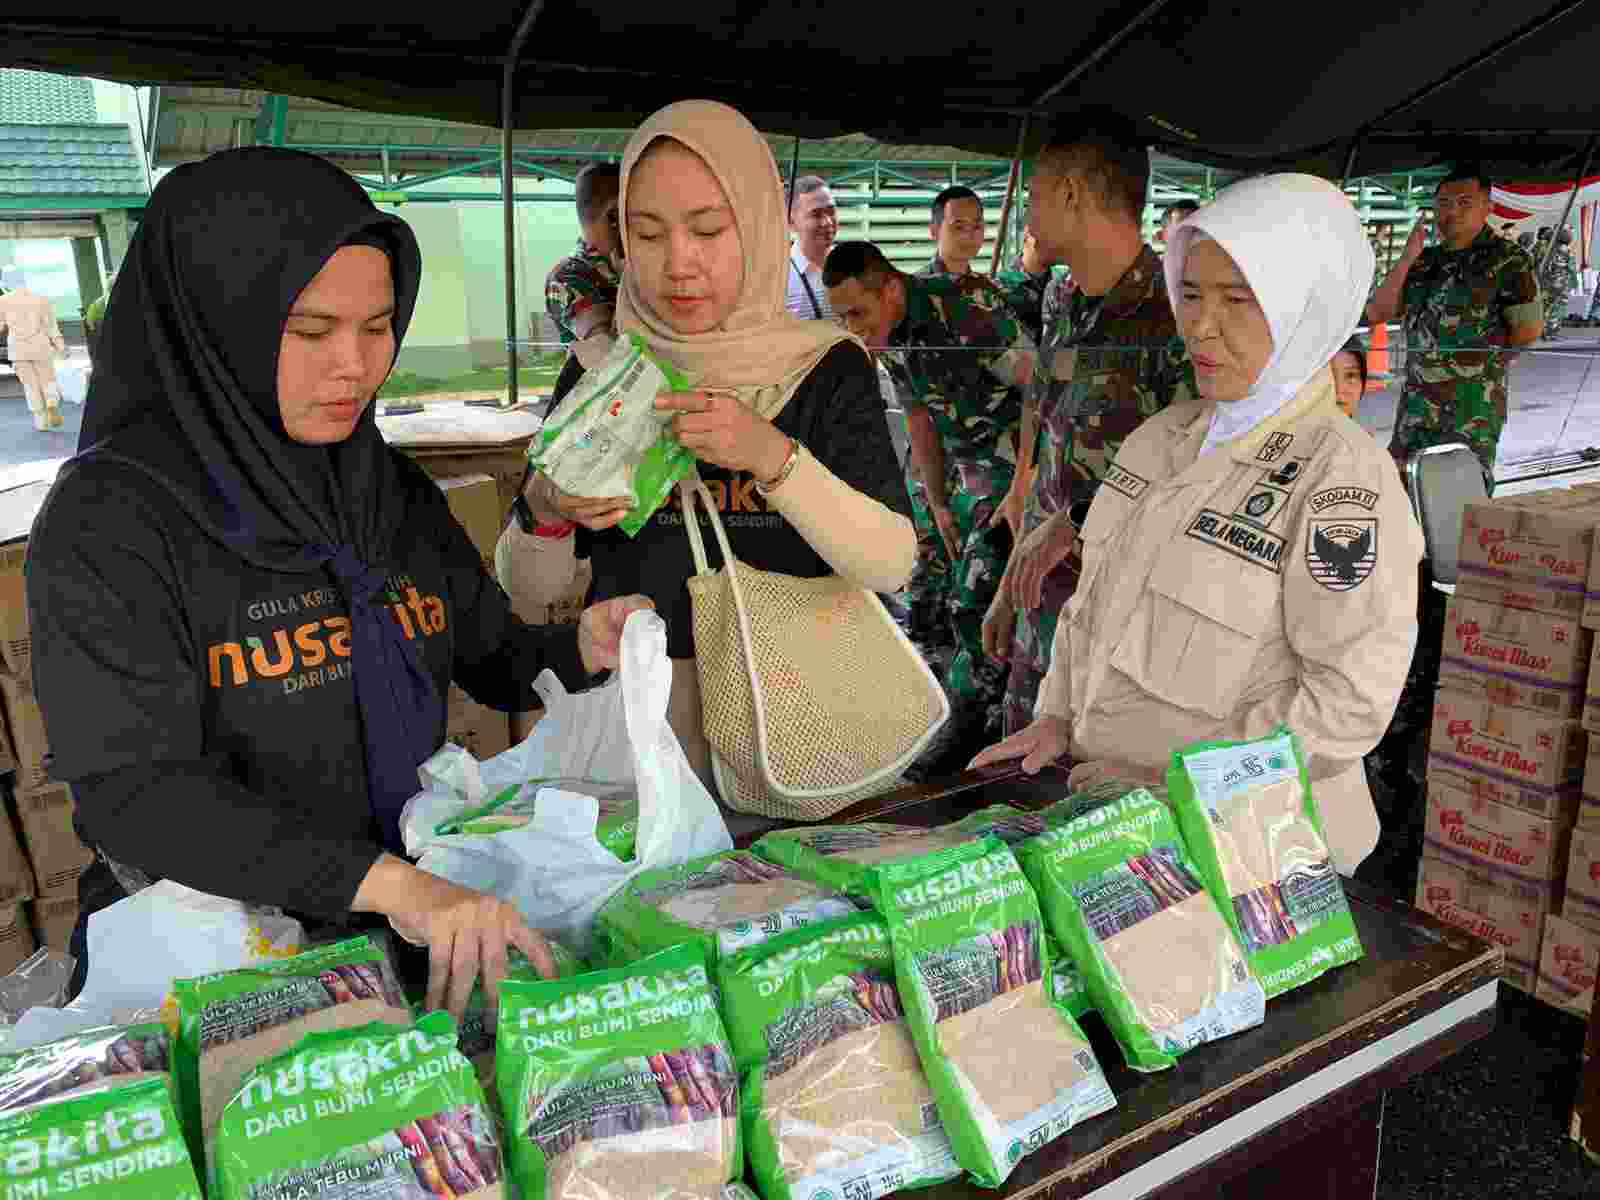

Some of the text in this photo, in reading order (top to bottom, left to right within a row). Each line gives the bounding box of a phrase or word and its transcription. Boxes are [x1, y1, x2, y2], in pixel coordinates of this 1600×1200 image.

[206, 584, 448, 689] nusaita
[245, 1104, 309, 1138] DARI
[314, 1088, 374, 1118] BUMI
[316, 1165, 362, 1193] TEBU
[365, 1142, 423, 1178] MURNI
